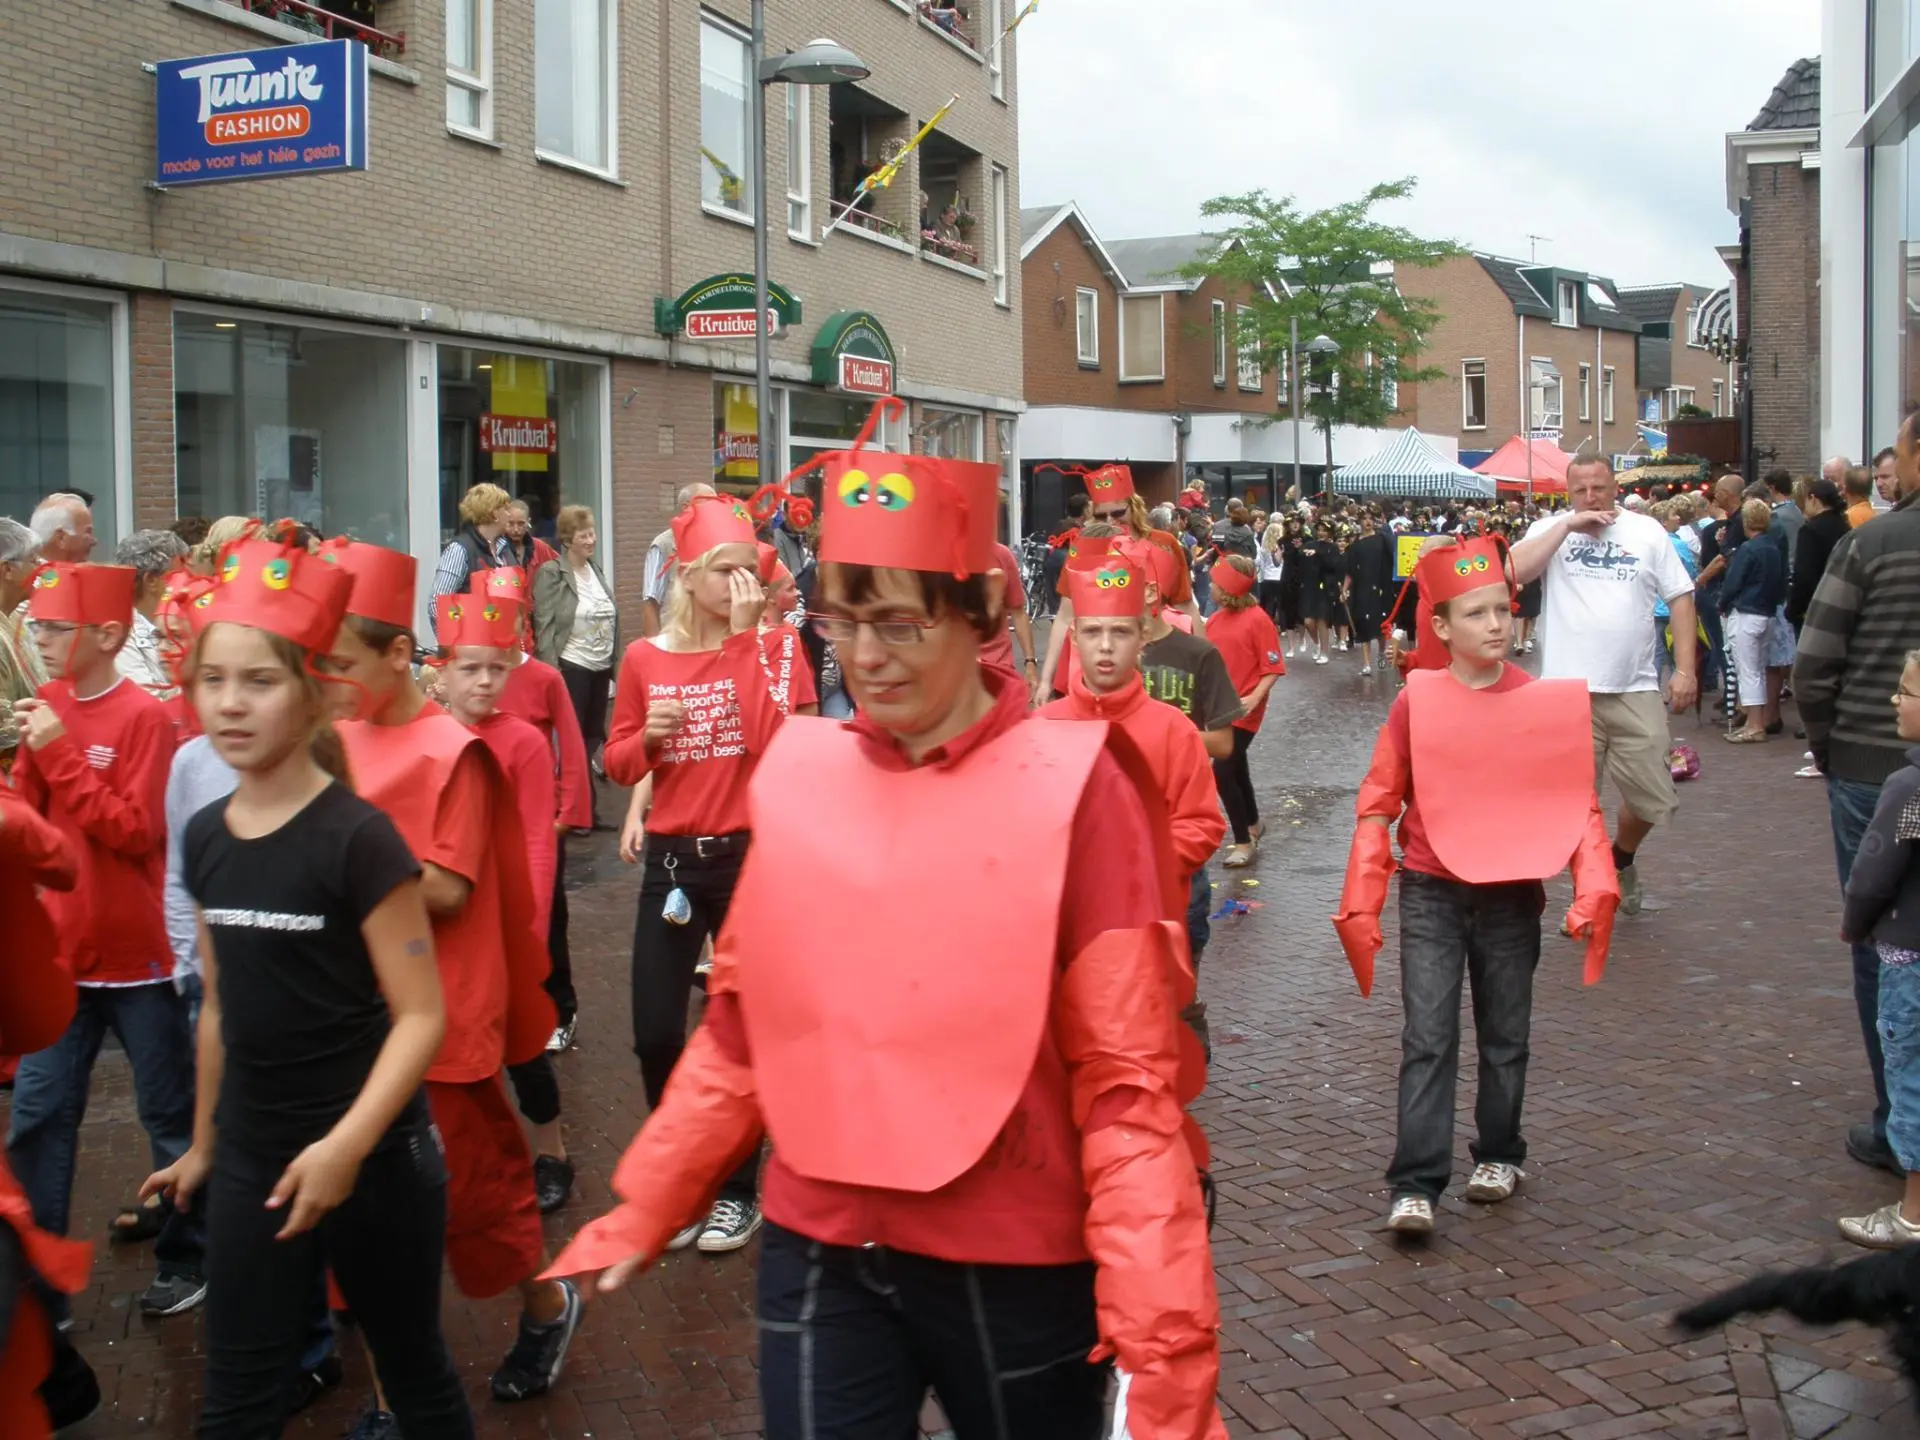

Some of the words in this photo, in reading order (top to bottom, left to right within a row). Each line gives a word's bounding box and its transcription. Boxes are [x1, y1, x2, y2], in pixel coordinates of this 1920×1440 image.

[178, 56, 323, 123] Tuunte
[215, 113, 300, 138] FASHION
[163, 157, 201, 174] mode
[206, 153, 236, 170] voor
[240, 150, 263, 166] het
[303, 143, 340, 162] gezin
[700, 316, 757, 333] Kruidva
[853, 363, 883, 387] Kruidvat
[491, 419, 548, 448] Kruidvat
[725, 434, 759, 459] Kruidva
[680, 682, 711, 697] your
[683, 693, 724, 709] sports
[688, 710, 706, 722] up
